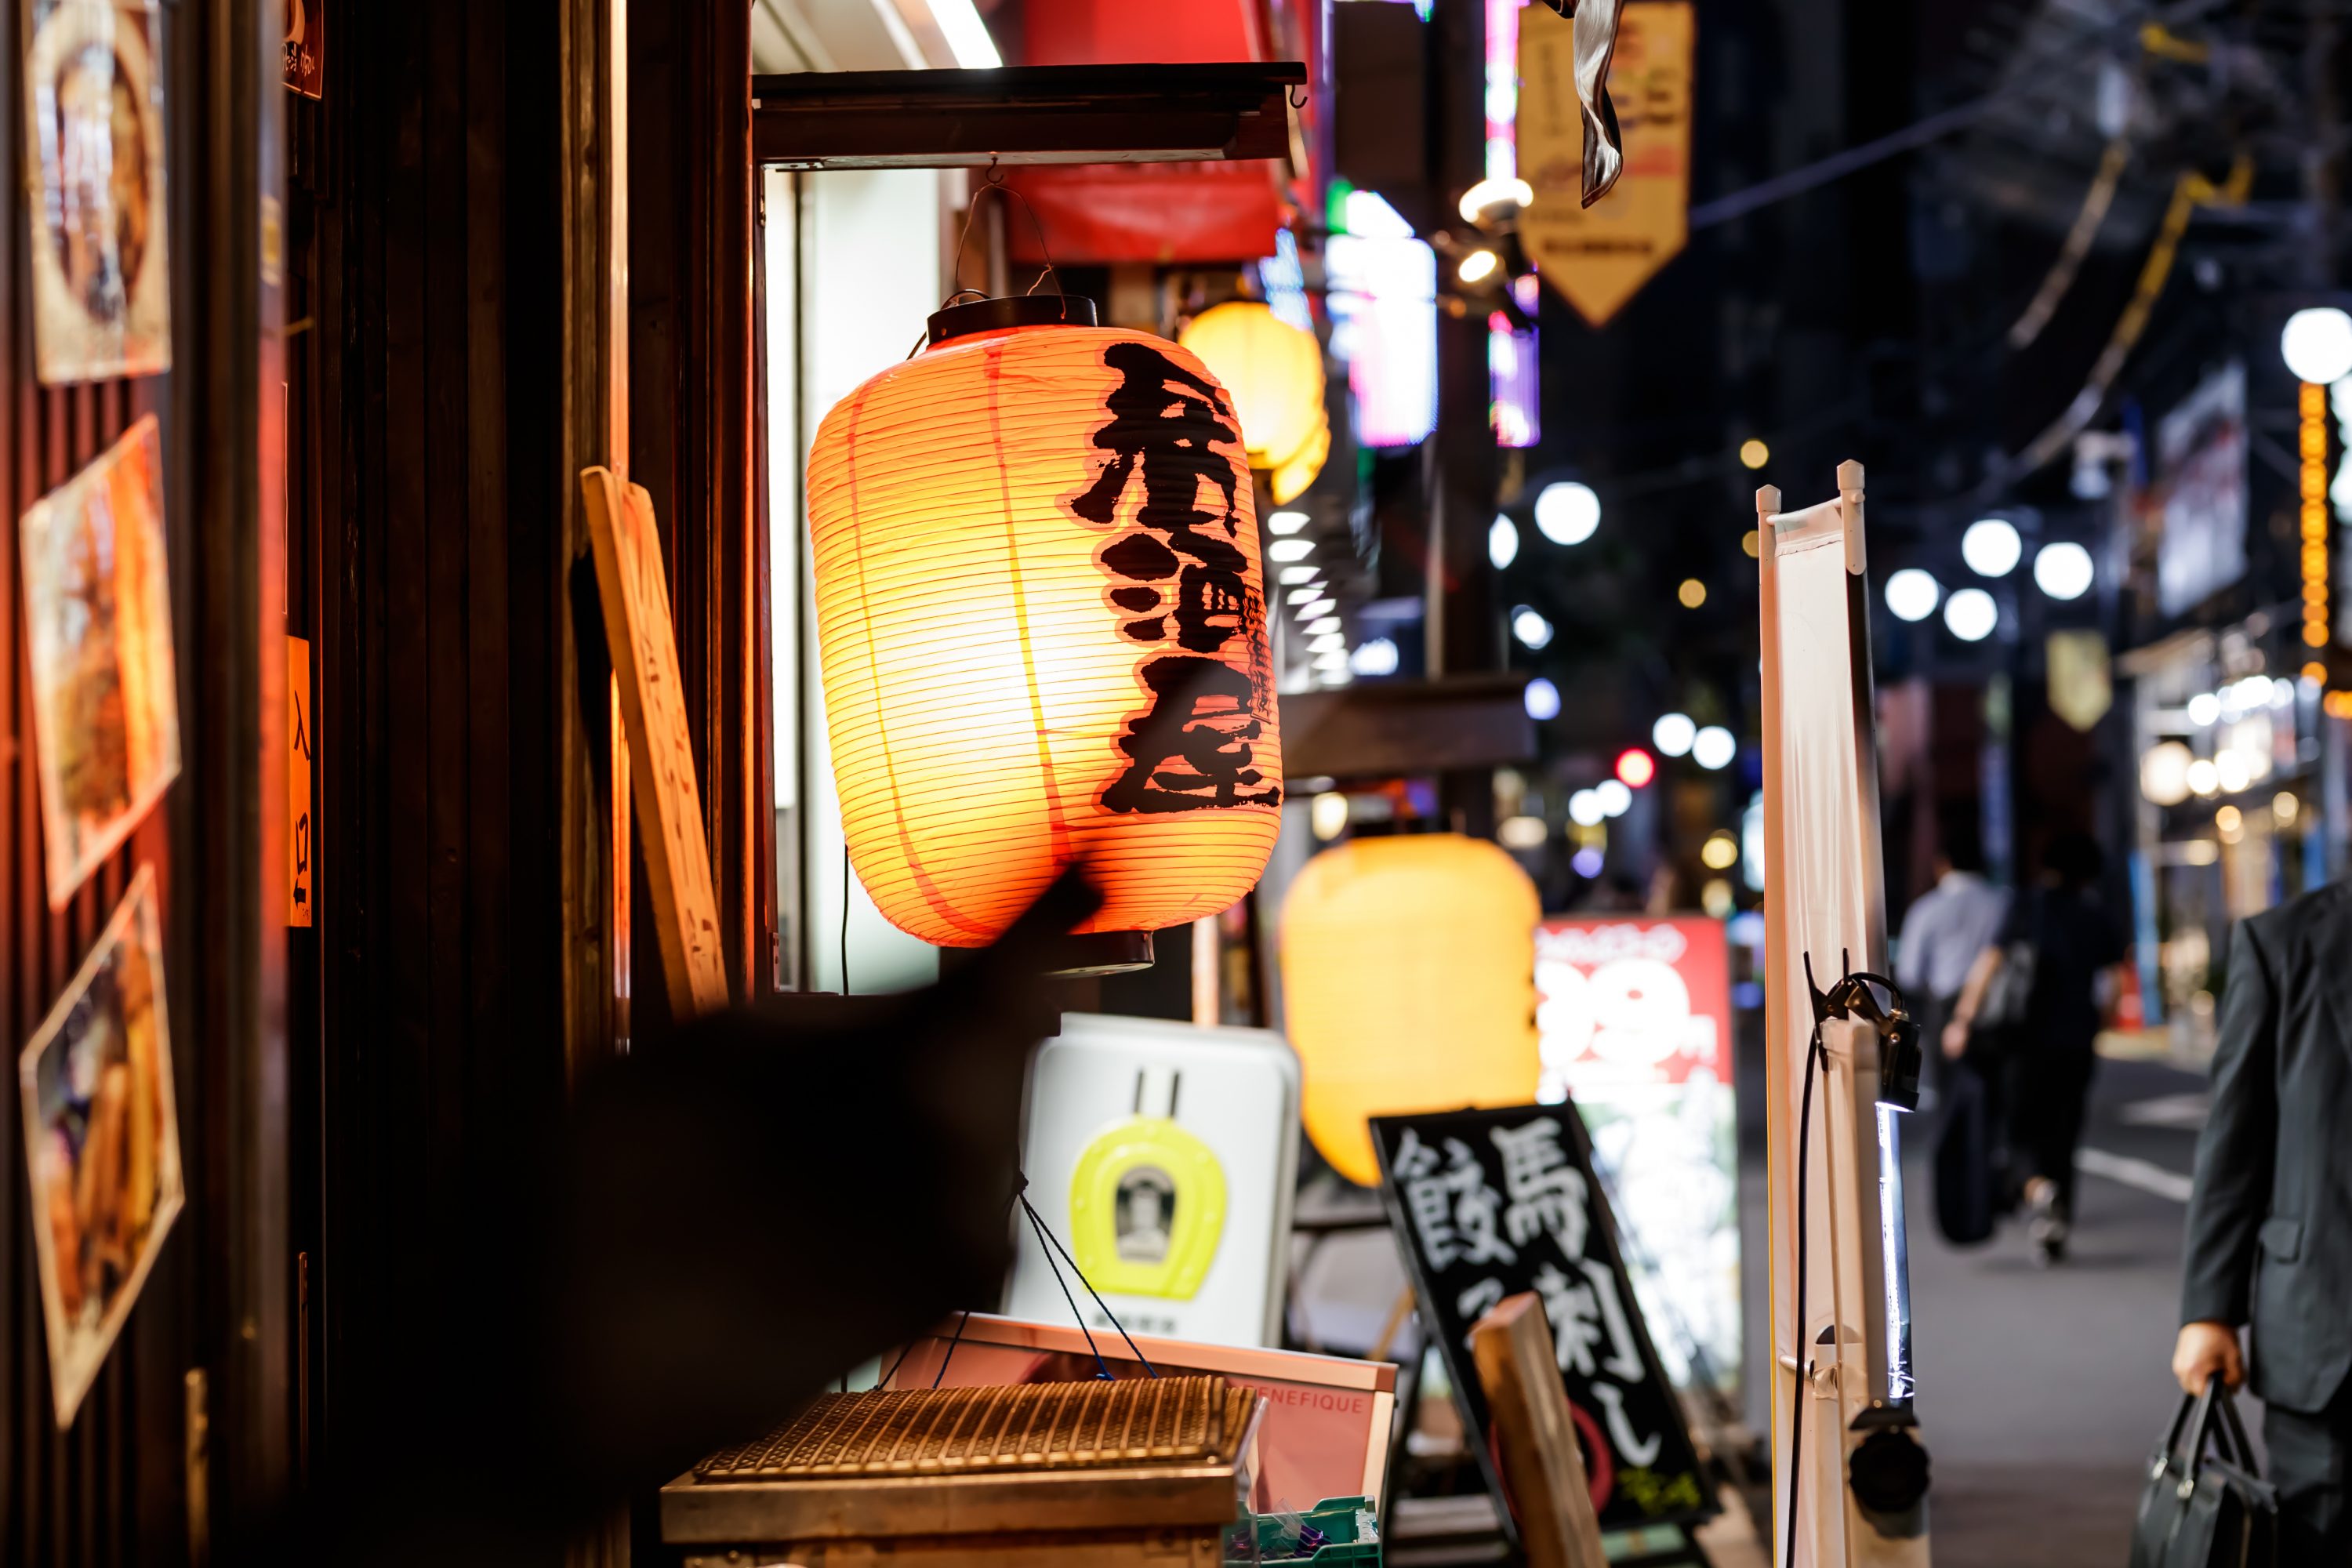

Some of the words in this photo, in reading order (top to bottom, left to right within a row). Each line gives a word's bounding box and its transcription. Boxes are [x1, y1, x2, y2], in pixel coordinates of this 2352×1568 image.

[293, 689, 311, 876] 入口
[1489, 1116, 1662, 1467] 馬刺し
[1245, 1385, 1363, 1414] ENEFIQUE
